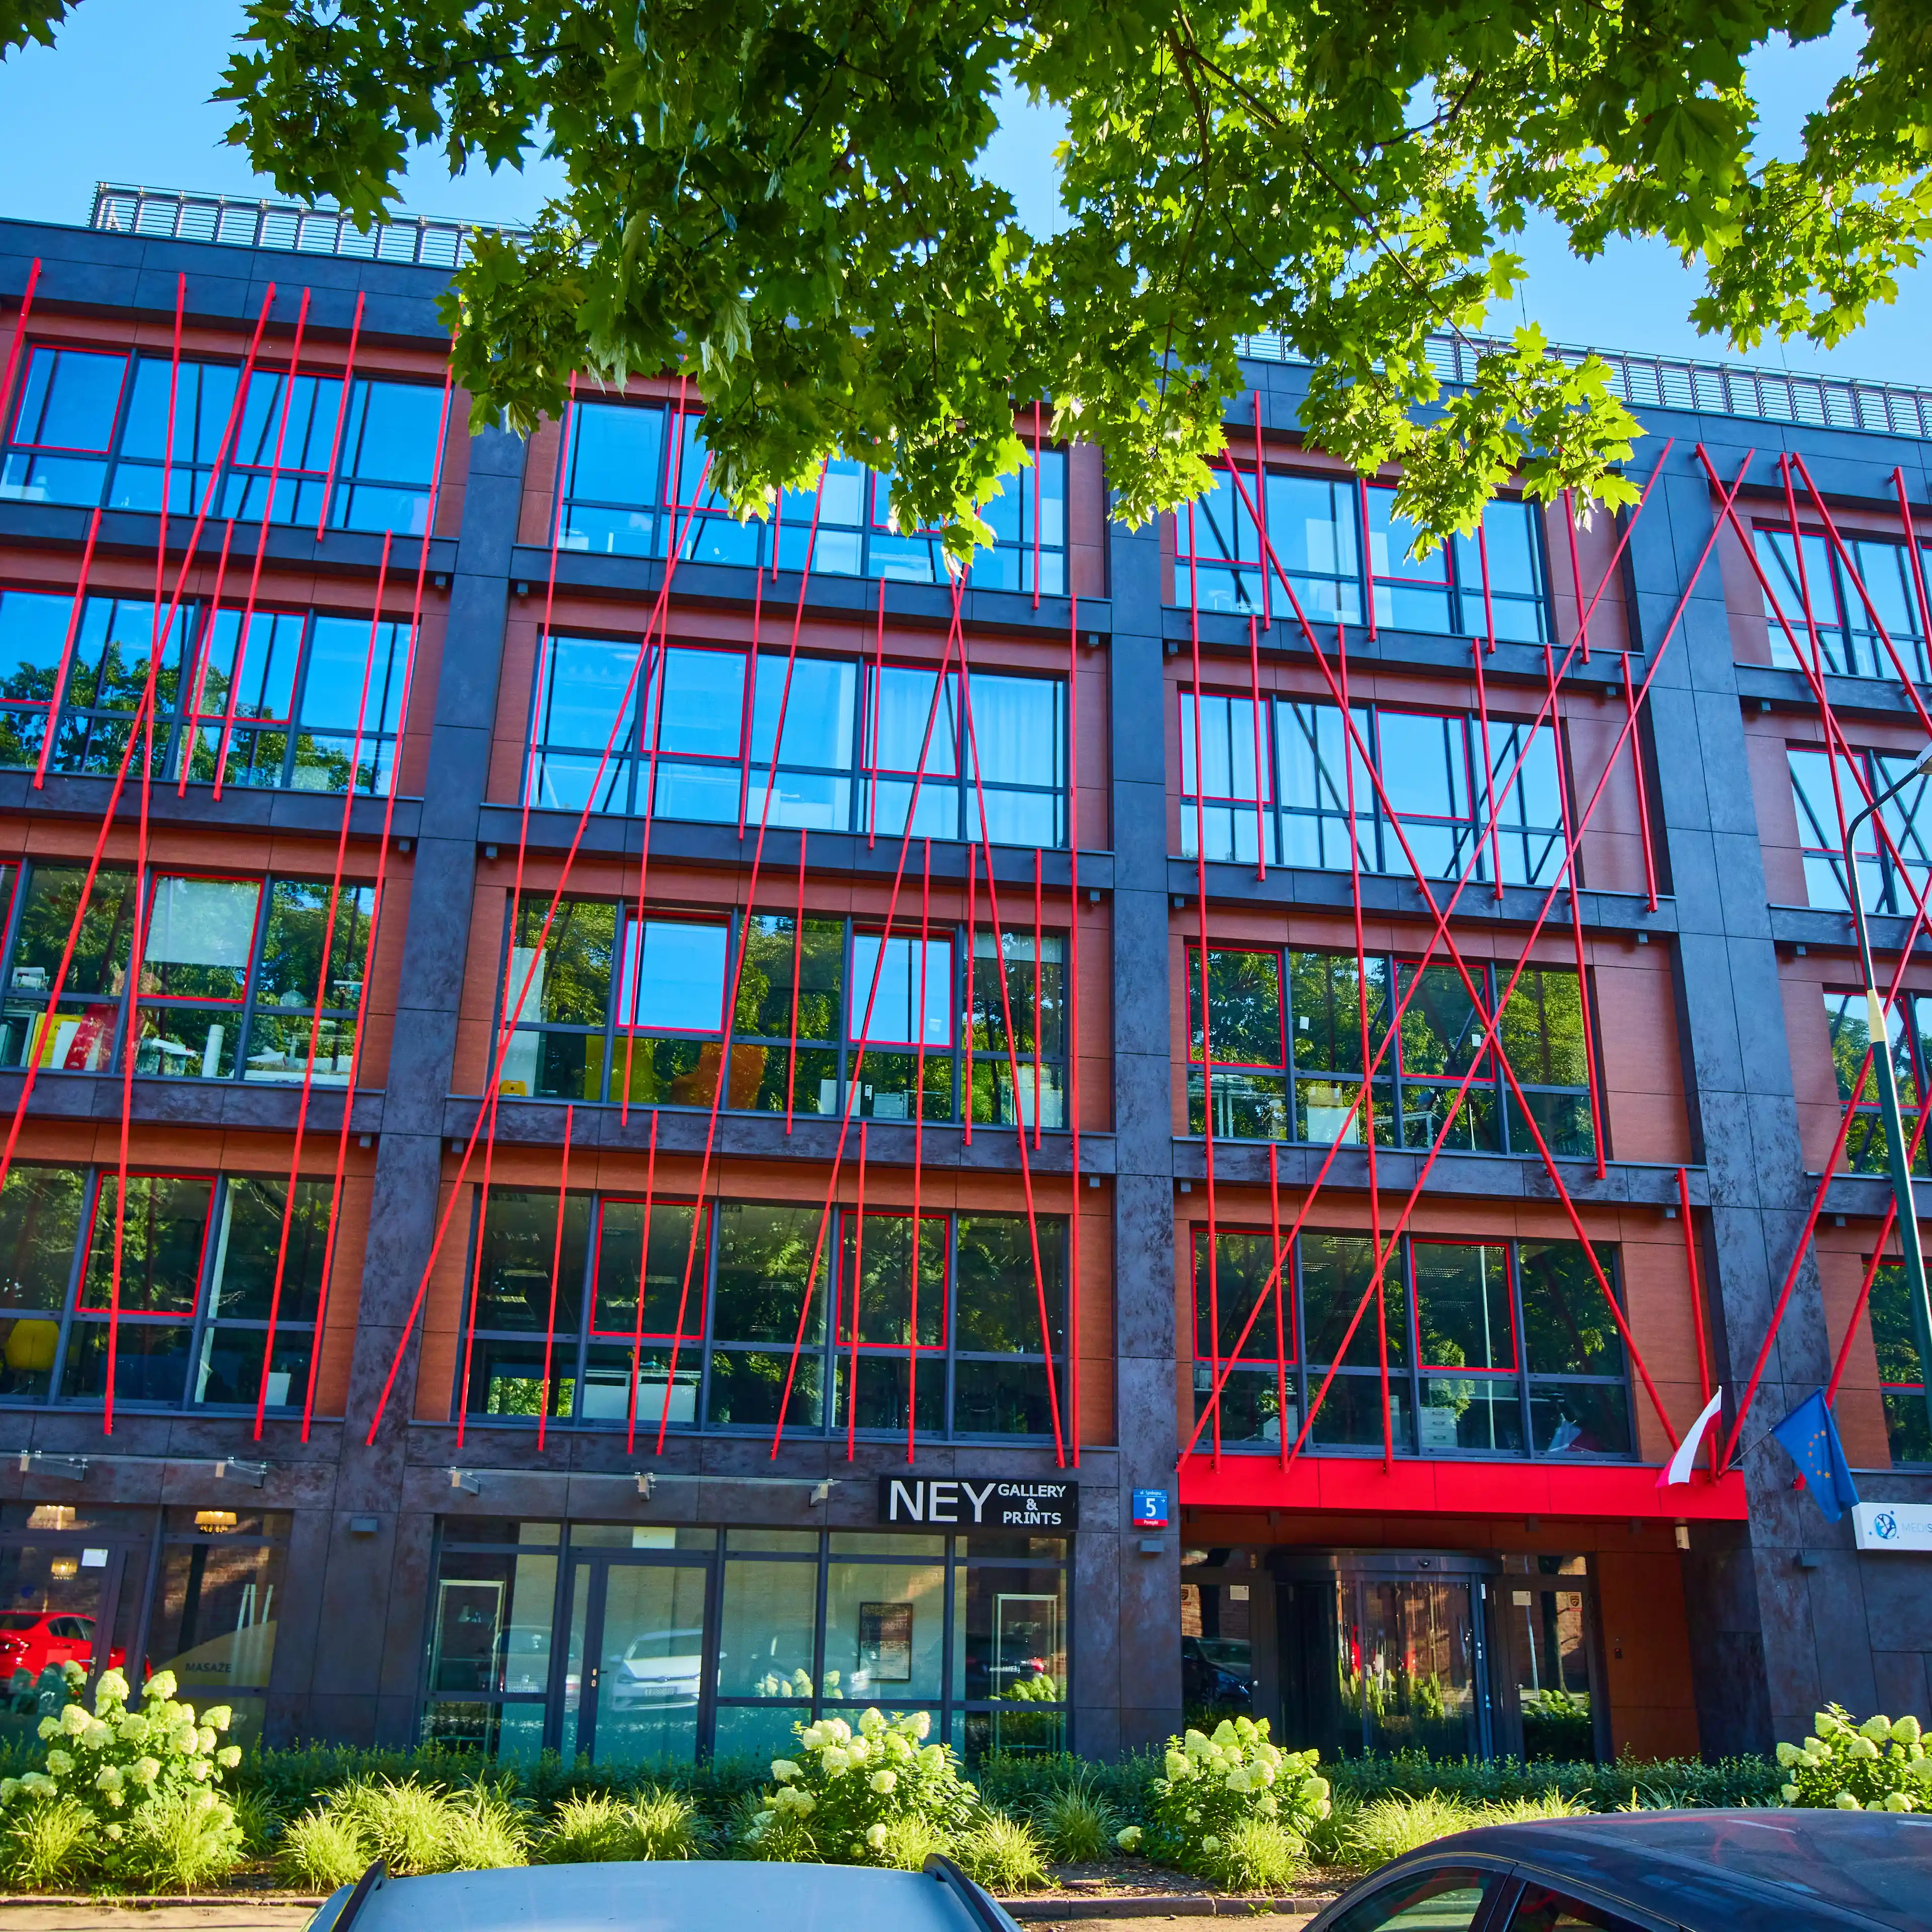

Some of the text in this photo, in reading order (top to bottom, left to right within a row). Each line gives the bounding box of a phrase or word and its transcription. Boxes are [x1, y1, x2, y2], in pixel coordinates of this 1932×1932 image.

[998, 1484, 1067, 1497] GALLERY
[890, 1480, 996, 1522] NEY
[1026, 1498, 1038, 1510] &
[1146, 1498, 1156, 1517] 5
[1003, 1511, 1062, 1524] PRINTS
